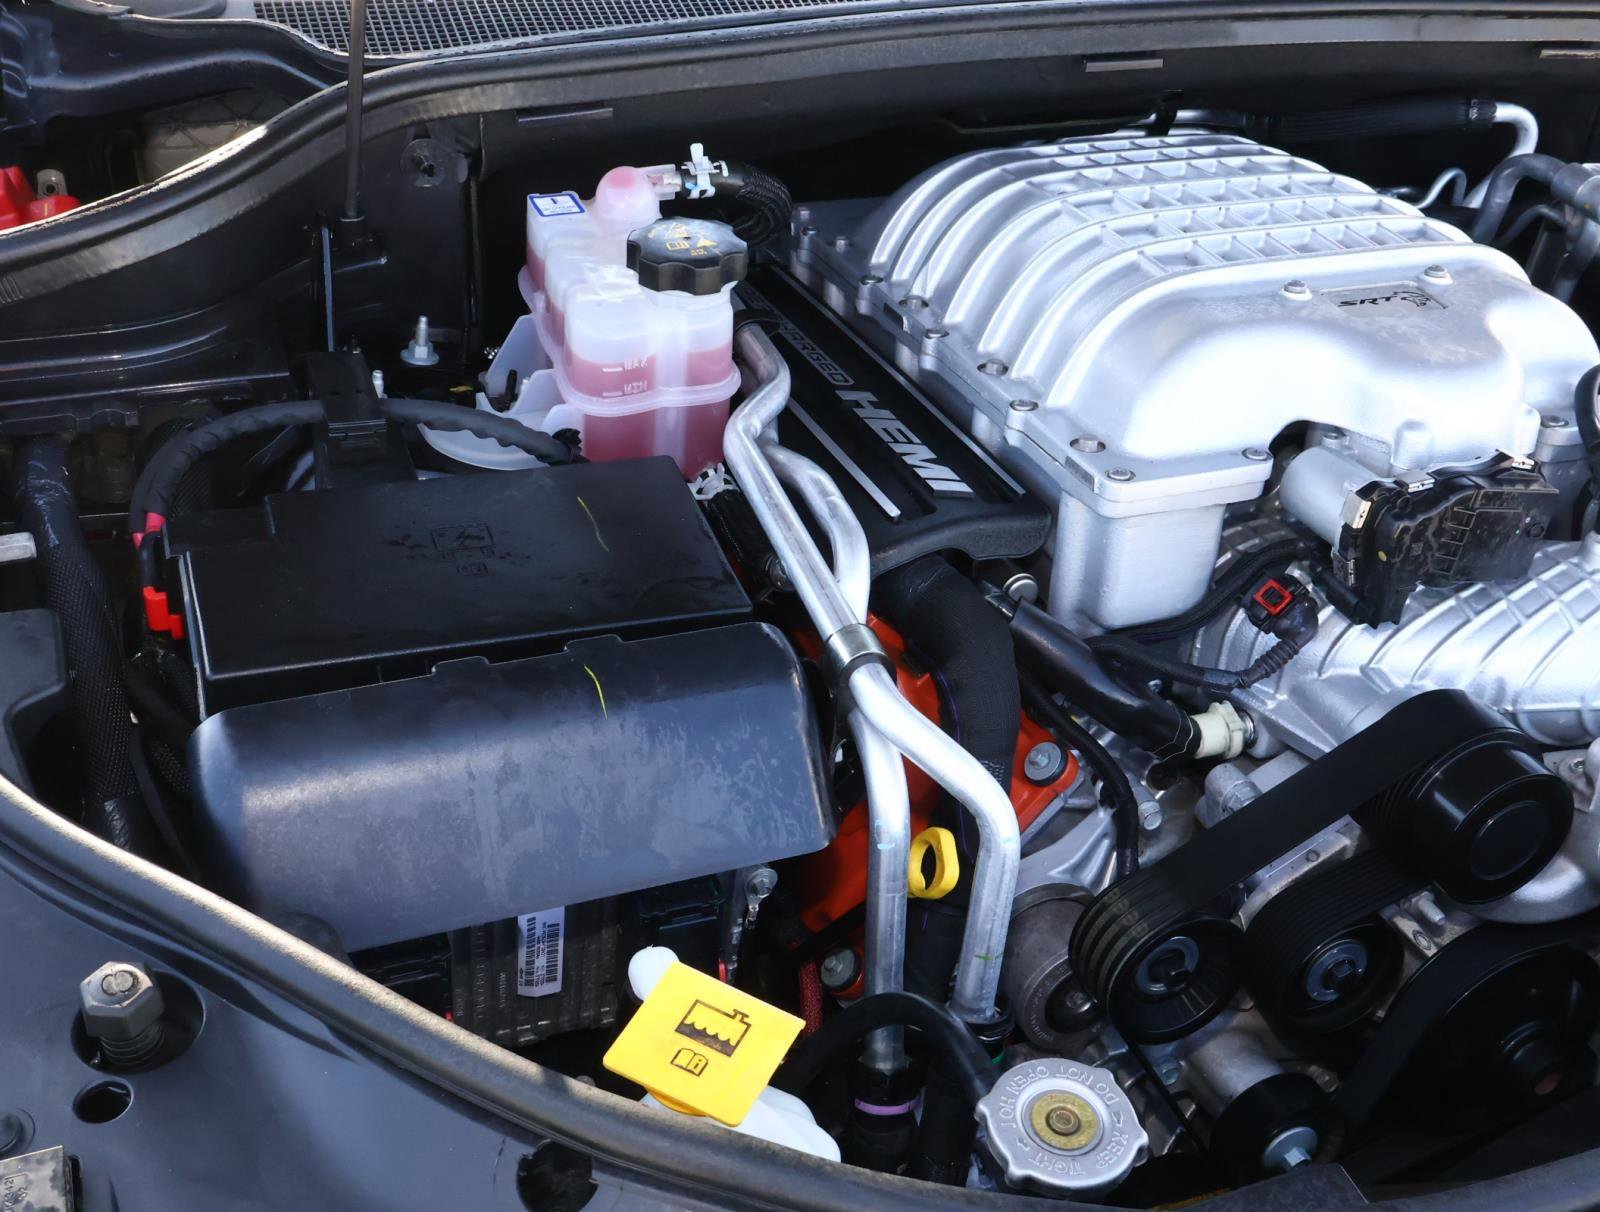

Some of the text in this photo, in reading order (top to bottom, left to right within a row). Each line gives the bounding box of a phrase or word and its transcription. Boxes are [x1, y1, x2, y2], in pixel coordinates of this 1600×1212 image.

[1337, 295, 1398, 307] SRT
[624, 380, 648, 394] MIN
[835, 390, 975, 493] HEMI
[999, 1065, 1120, 1128] DO NOT OPEN HOT
[1028, 1131, 1129, 1176] KEEP TIGHT
